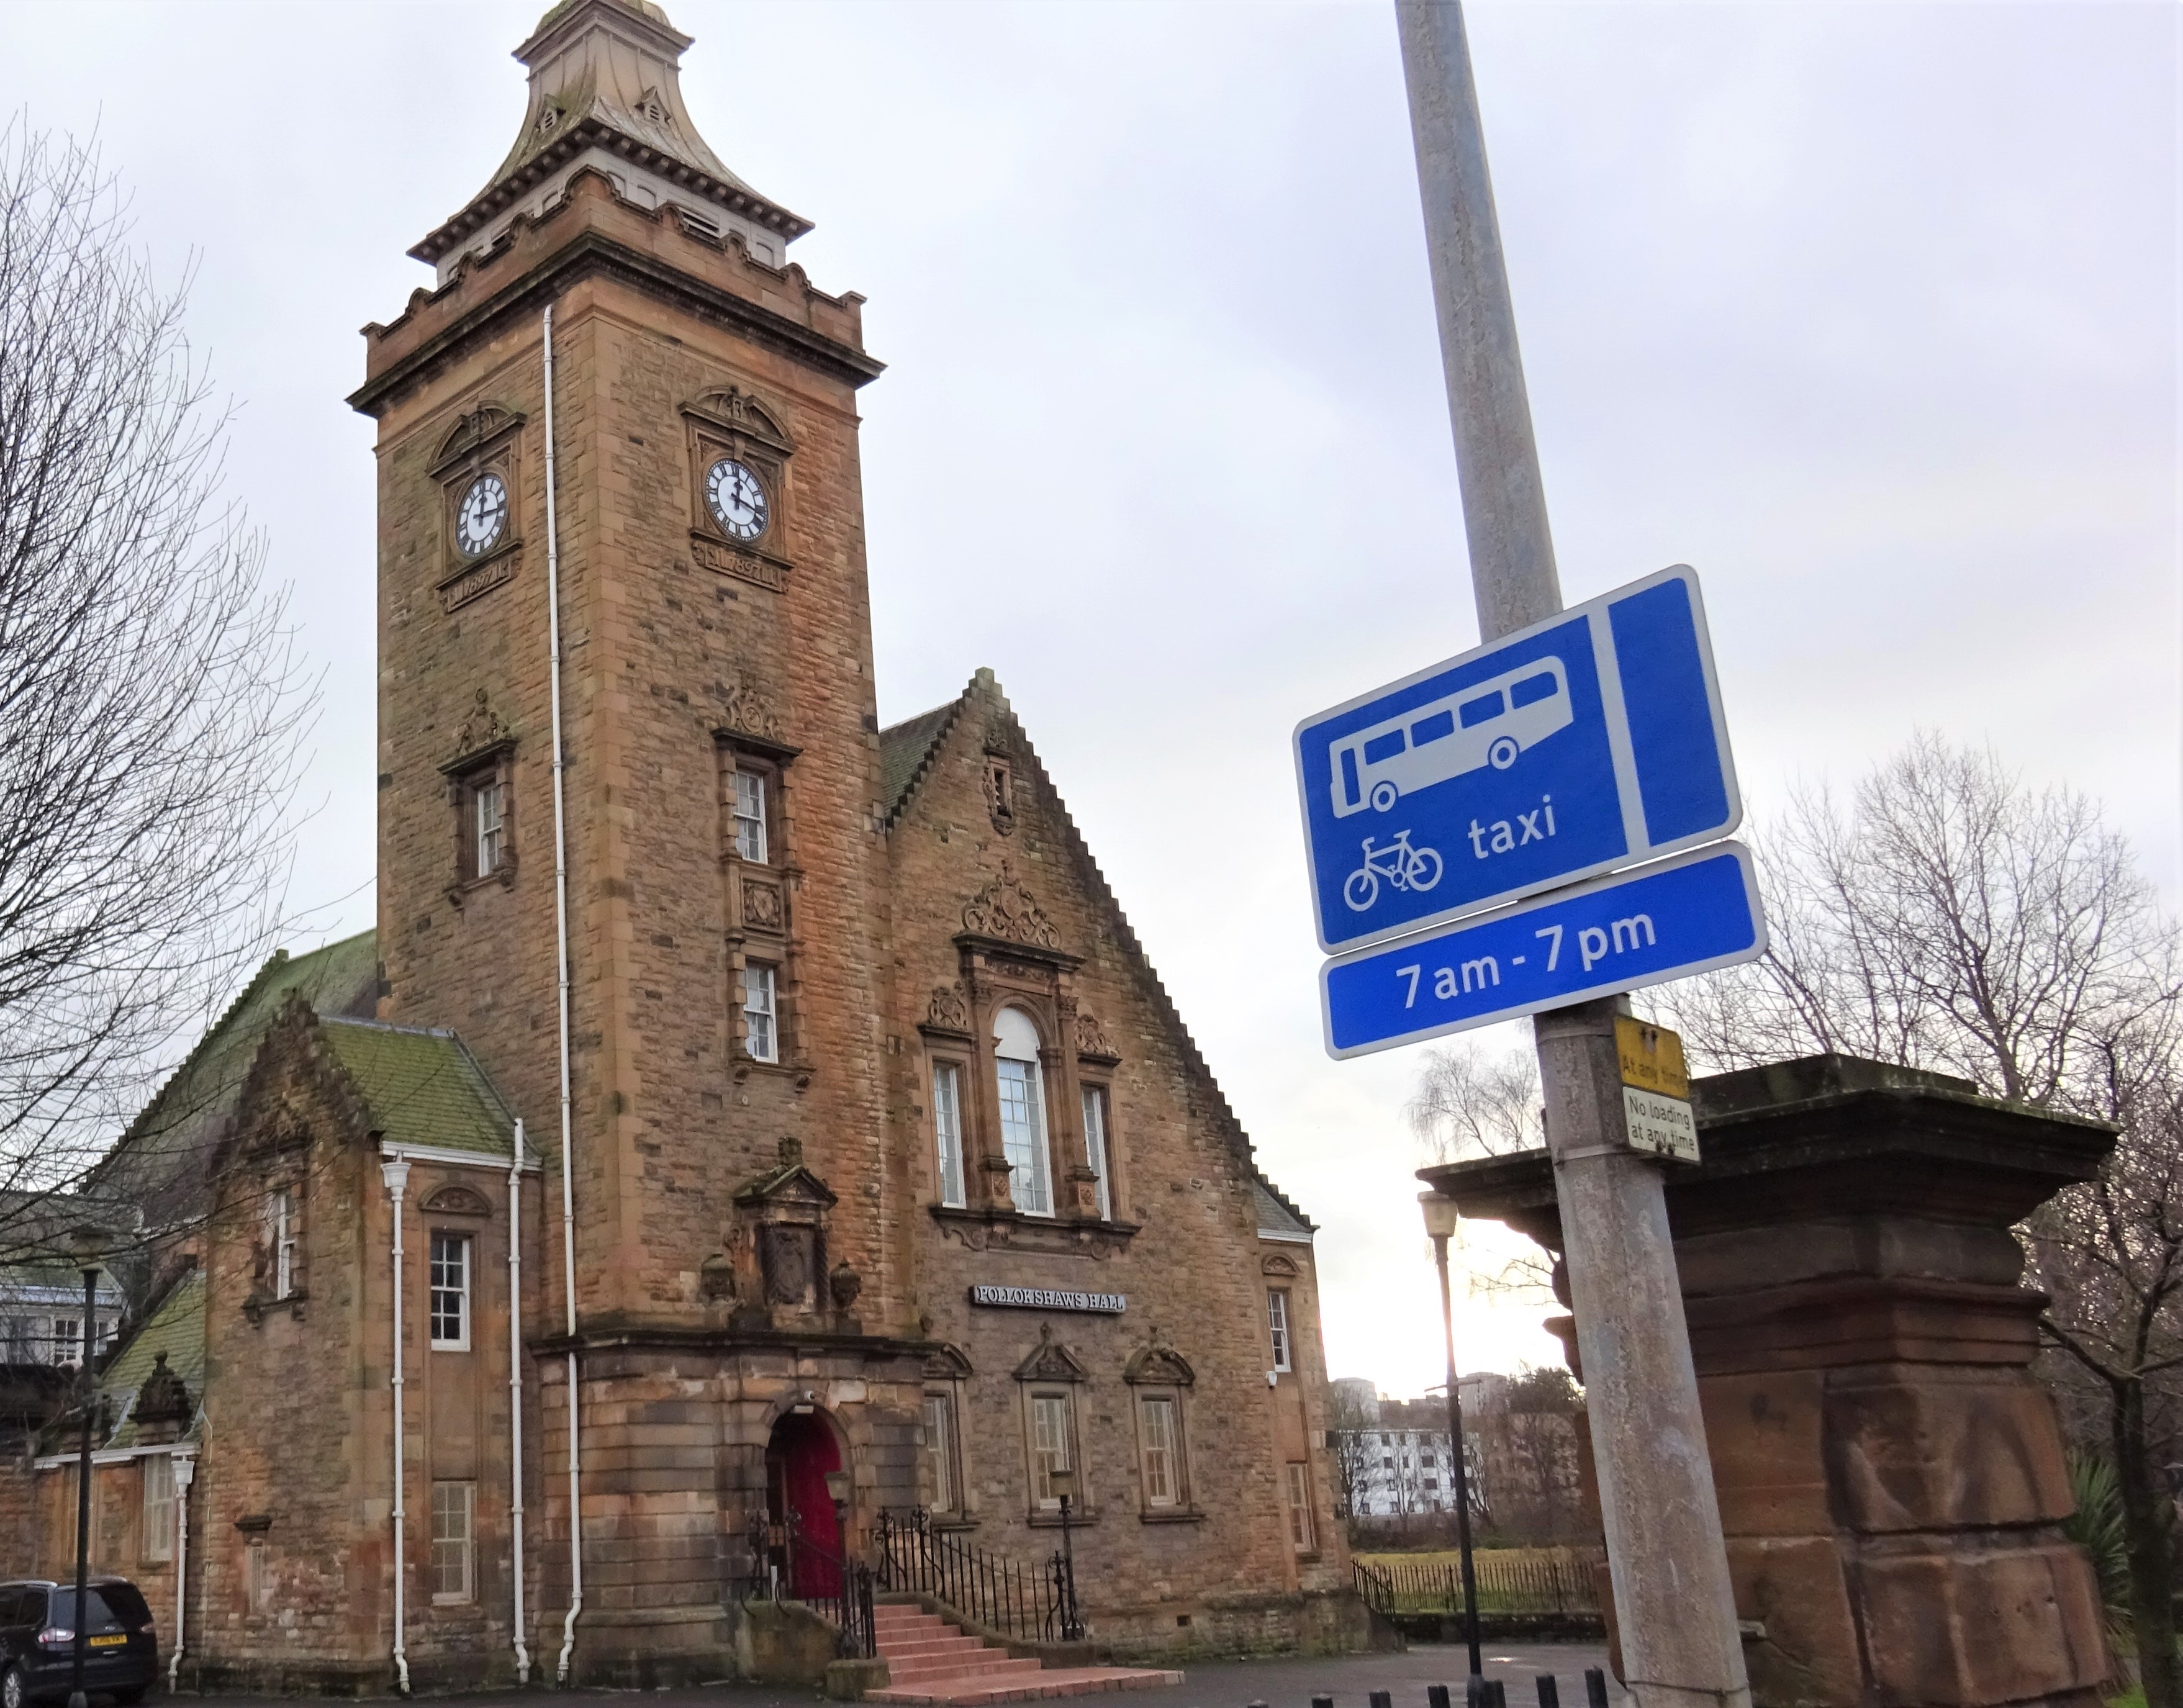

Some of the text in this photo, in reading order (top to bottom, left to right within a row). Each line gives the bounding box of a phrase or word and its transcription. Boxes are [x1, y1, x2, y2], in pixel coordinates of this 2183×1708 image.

[1468, 795, 1555, 859] taxi
[1622, 1055, 1635, 1075] At
[1629, 1096, 1690, 1130] No loading
[1631, 1122, 1694, 1151] at any time
[979, 1286, 1123, 1309] POLLOKSHAWS HALL
